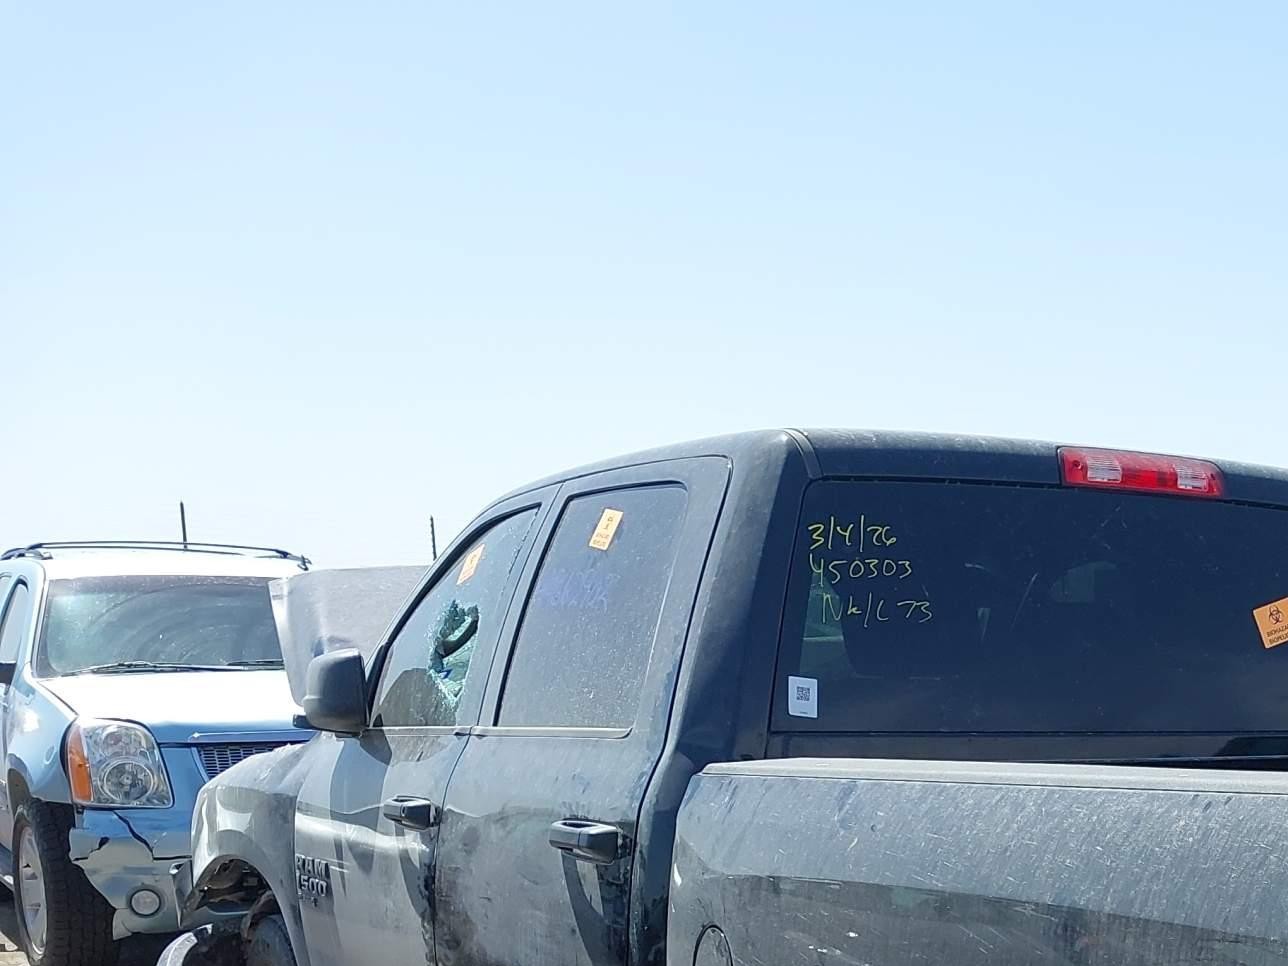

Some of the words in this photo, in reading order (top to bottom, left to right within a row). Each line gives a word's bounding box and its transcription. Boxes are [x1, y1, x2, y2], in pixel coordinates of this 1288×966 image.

[807, 514, 897, 553] 3/4/26
[809, 552, 913, 588] 450303
[295, 853, 330, 880] RAM
